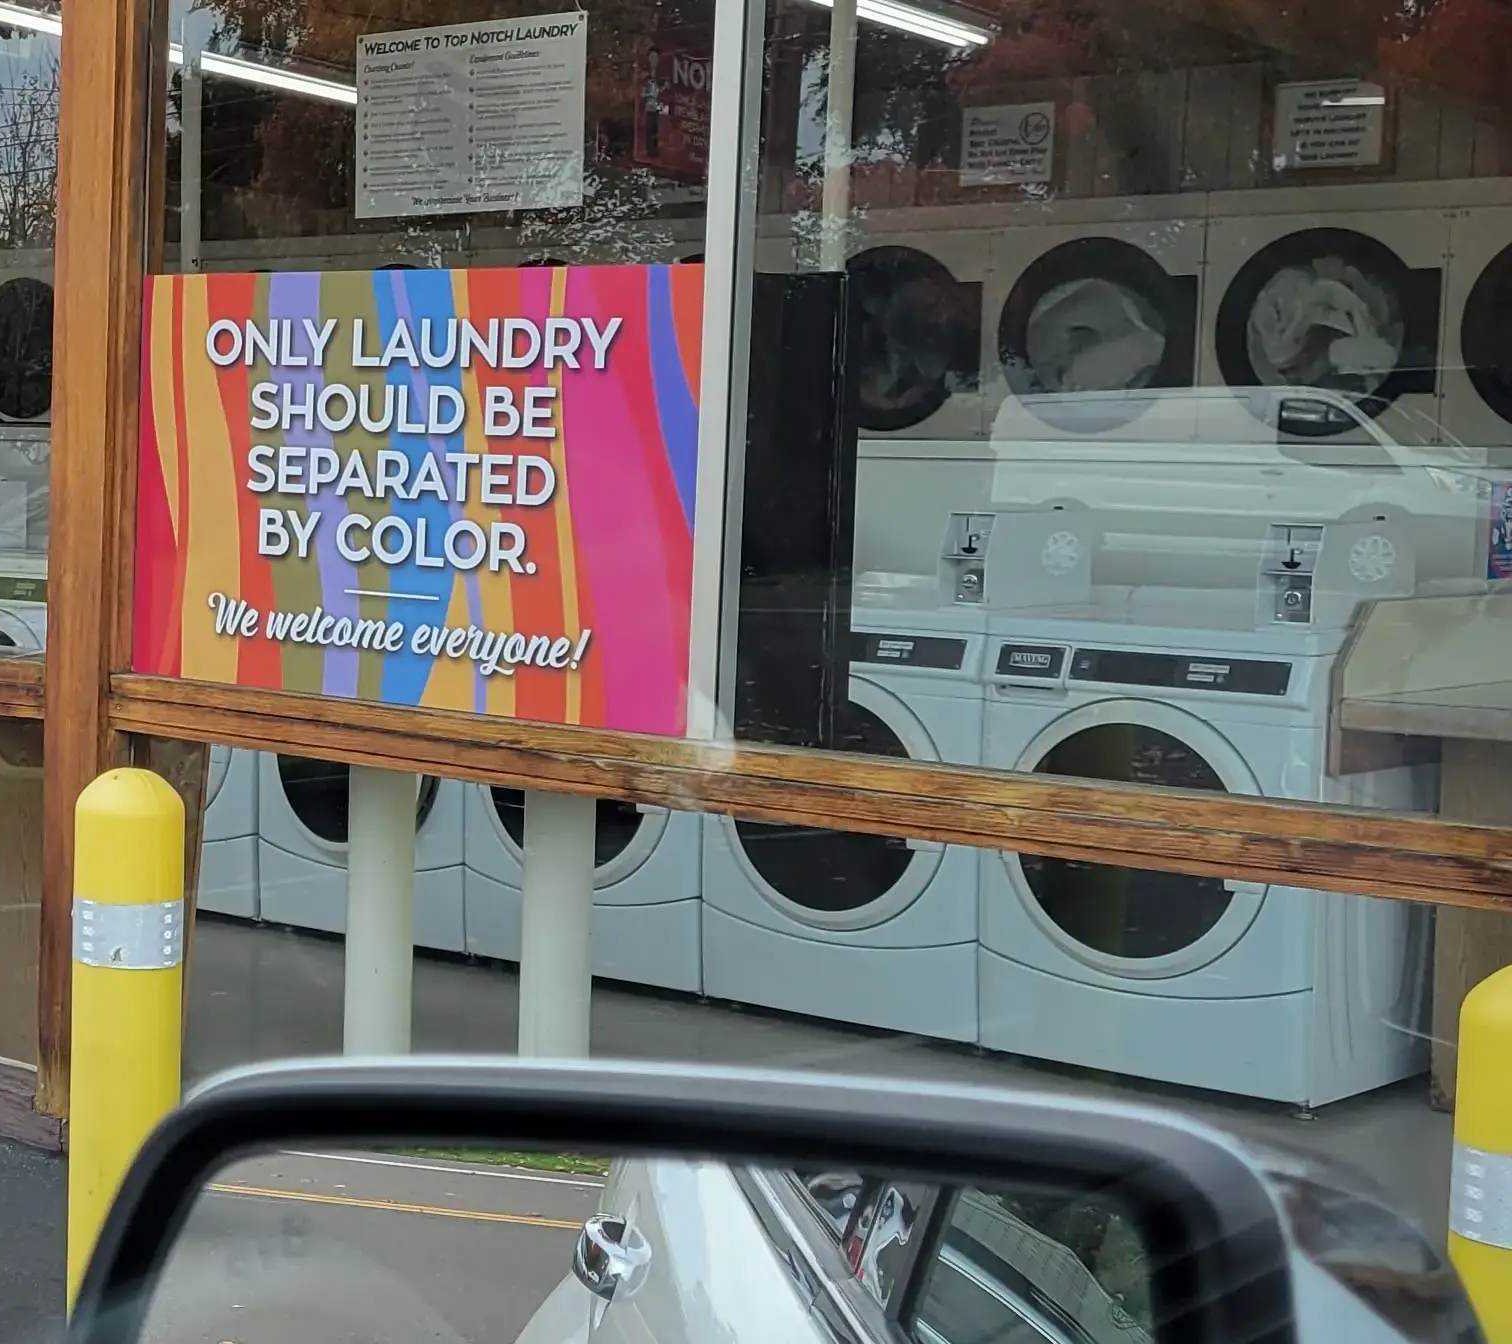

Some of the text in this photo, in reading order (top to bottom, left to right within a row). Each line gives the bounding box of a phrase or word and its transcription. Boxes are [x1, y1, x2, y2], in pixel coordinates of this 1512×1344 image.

[364, 23, 578, 56] WELCOME TO TOP NOTCH LAUNDRY
[205, 317, 623, 369] ONLY LAUNDRY
[249, 382, 557, 438] SHOULD BE
[246, 444, 555, 506] SEPARATED
[258, 508, 537, 575] BY COLOR.
[207, 591, 591, 676] We welcome everyone!
